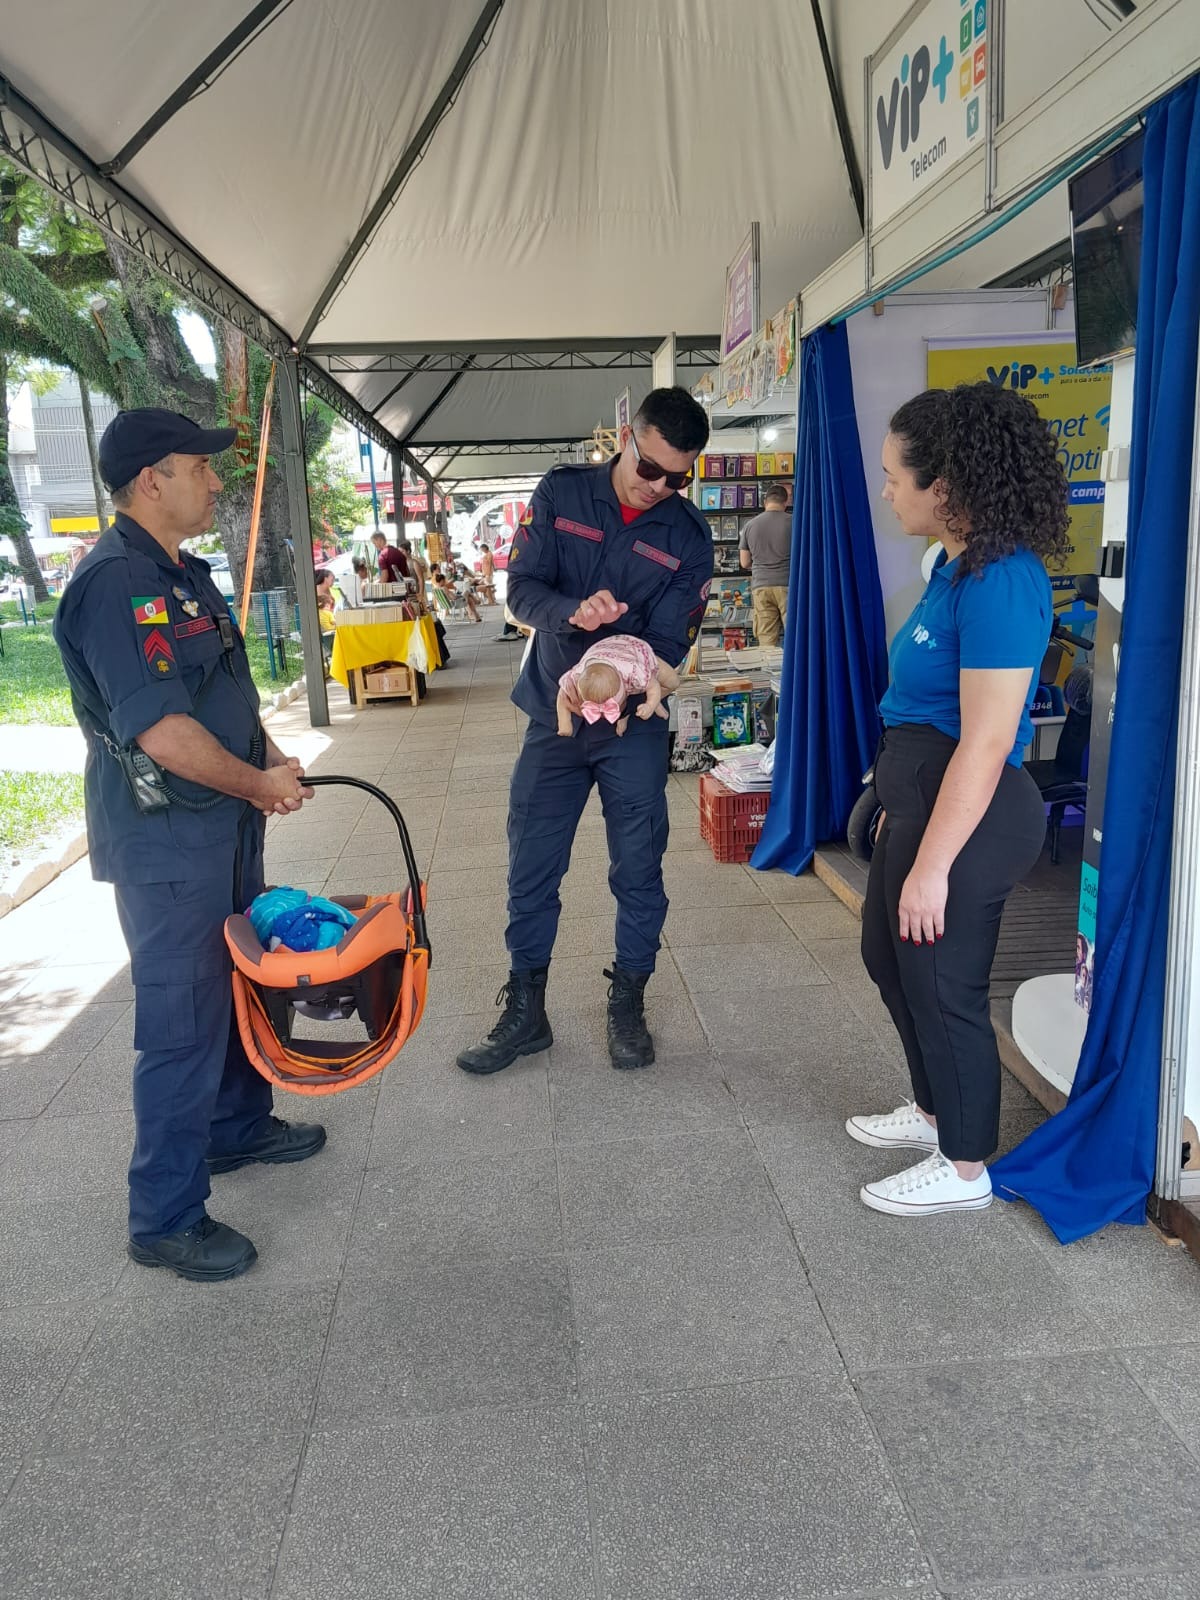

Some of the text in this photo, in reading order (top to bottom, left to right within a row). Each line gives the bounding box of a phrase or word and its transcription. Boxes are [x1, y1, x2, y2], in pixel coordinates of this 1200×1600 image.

[910, 135, 947, 181] Telecom
[1046, 413, 1089, 438] net
[1056, 441, 1101, 478] Ópti
[1071, 484, 1105, 500] camp
[1082, 877, 1098, 898] Saib
